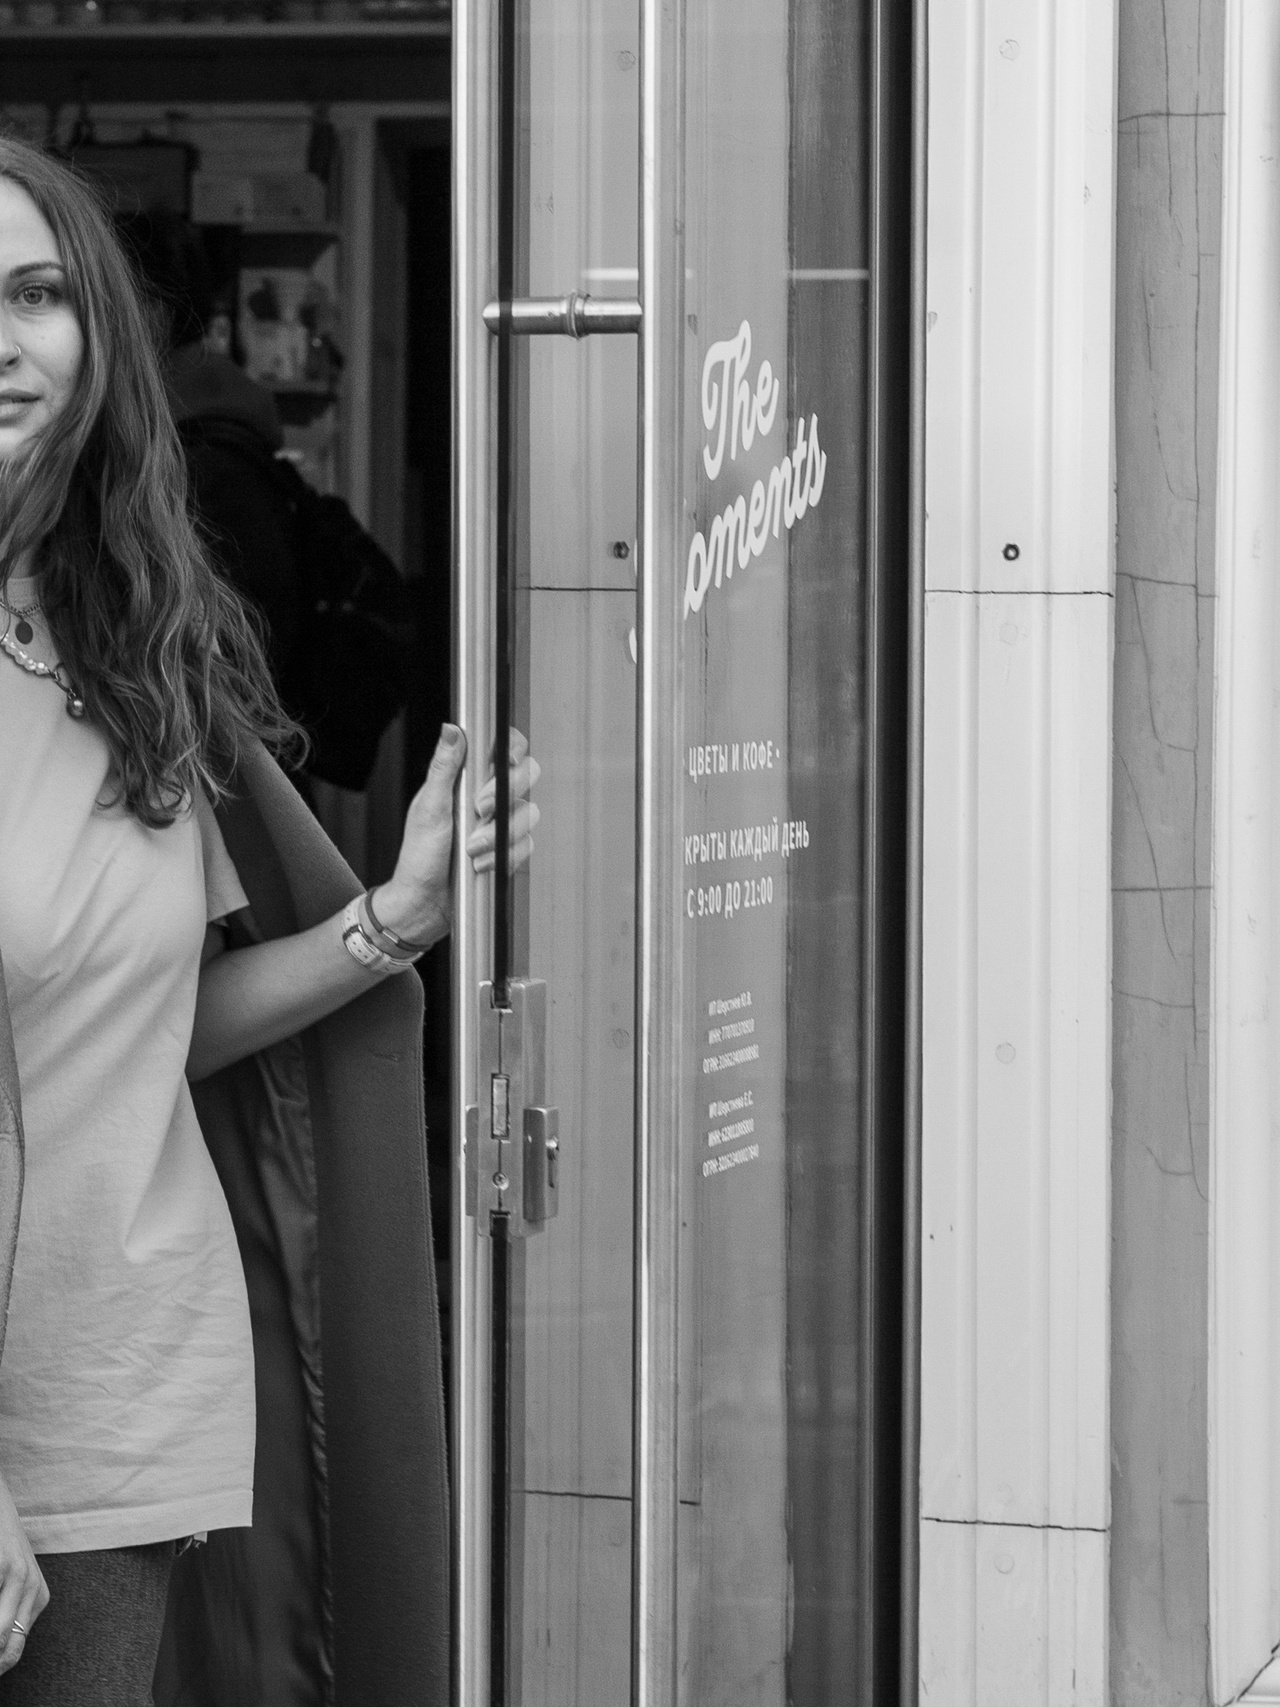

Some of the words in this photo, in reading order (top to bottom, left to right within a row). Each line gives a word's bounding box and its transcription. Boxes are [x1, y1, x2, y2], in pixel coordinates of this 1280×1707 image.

[702, 319, 779, 480] The
[683, 413, 827, 620] oments
[689, 744, 728, 784] ЦВЕТЫ
[732, 743, 740, 772] И
[743, 740, 773, 771] КОФЕ
[683, 831, 727, 866] КРЫТЫ
[730, 816, 778, 862] КАЖДЫЙ
[782, 820, 810, 859] ДЕНЬ
[687, 888, 695, 919] С
[698, 885, 721, 917] 9:00
[724, 881, 741, 919] ДО
[744, 876, 773, 908] 21:00
